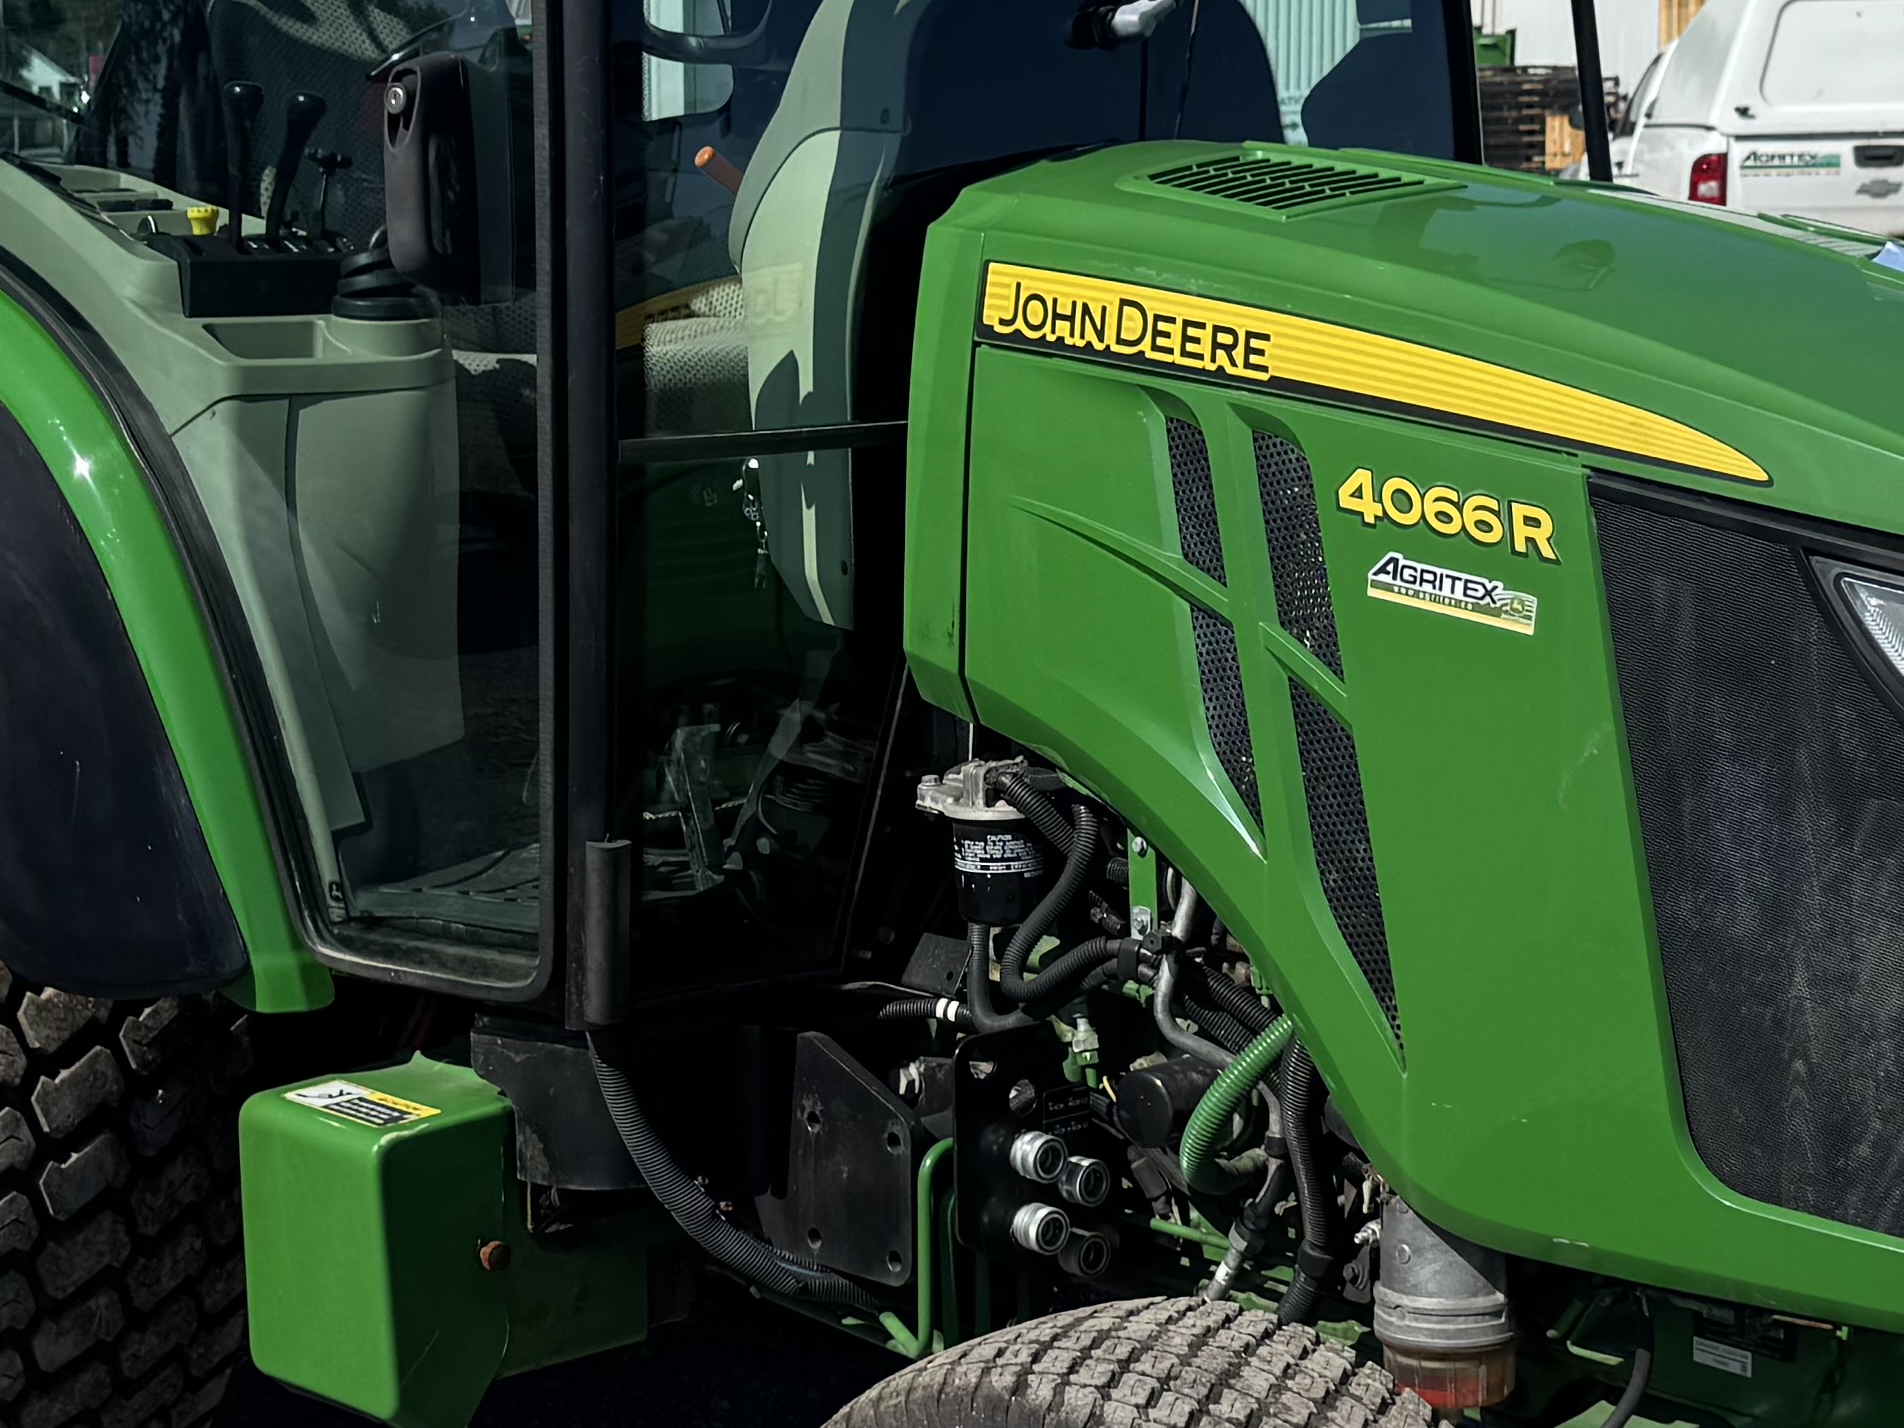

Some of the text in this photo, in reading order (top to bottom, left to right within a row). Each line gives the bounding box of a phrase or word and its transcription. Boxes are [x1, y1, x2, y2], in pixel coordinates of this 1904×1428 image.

[998, 281, 1272, 374] JOHN DEERE
[1338, 468, 1559, 562] 4066R
[1372, 556, 1499, 605] AGRITEX
